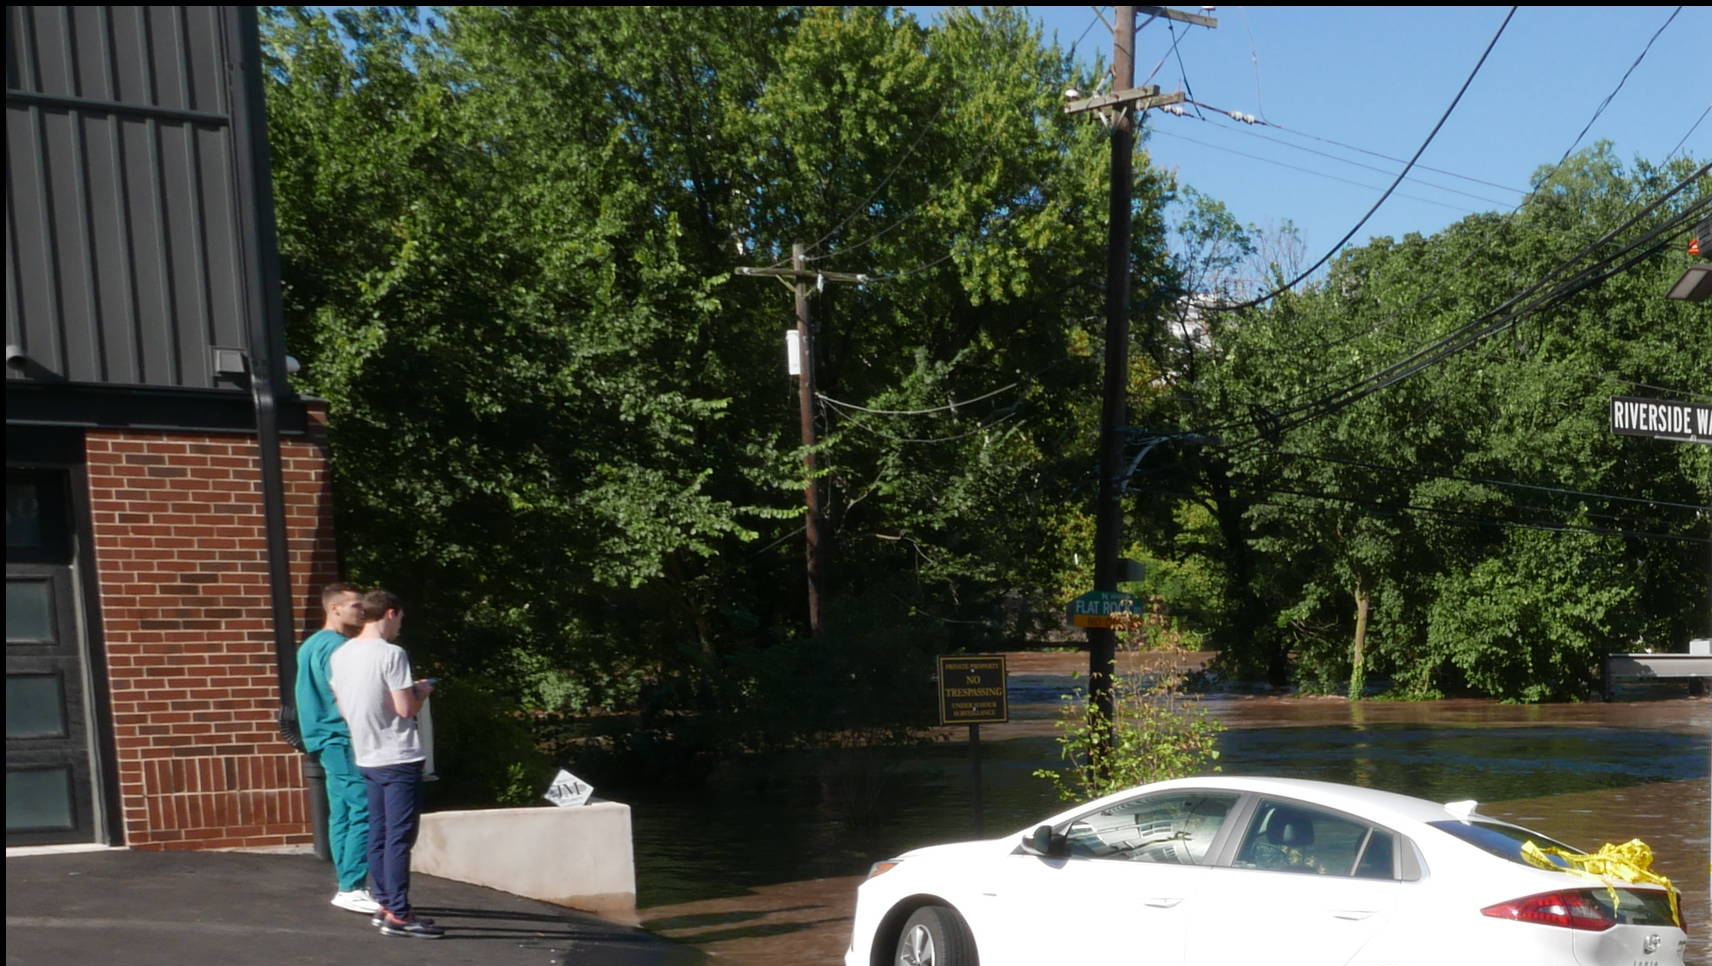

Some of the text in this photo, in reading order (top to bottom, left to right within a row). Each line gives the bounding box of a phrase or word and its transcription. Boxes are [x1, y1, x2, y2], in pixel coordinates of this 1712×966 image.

[1614, 401, 1692, 433] RIVERSIDE
[1076, 600, 1100, 614] FLAT
[966, 675, 981, 685] NO
[945, 687, 1002, 697] TRESPASSING
